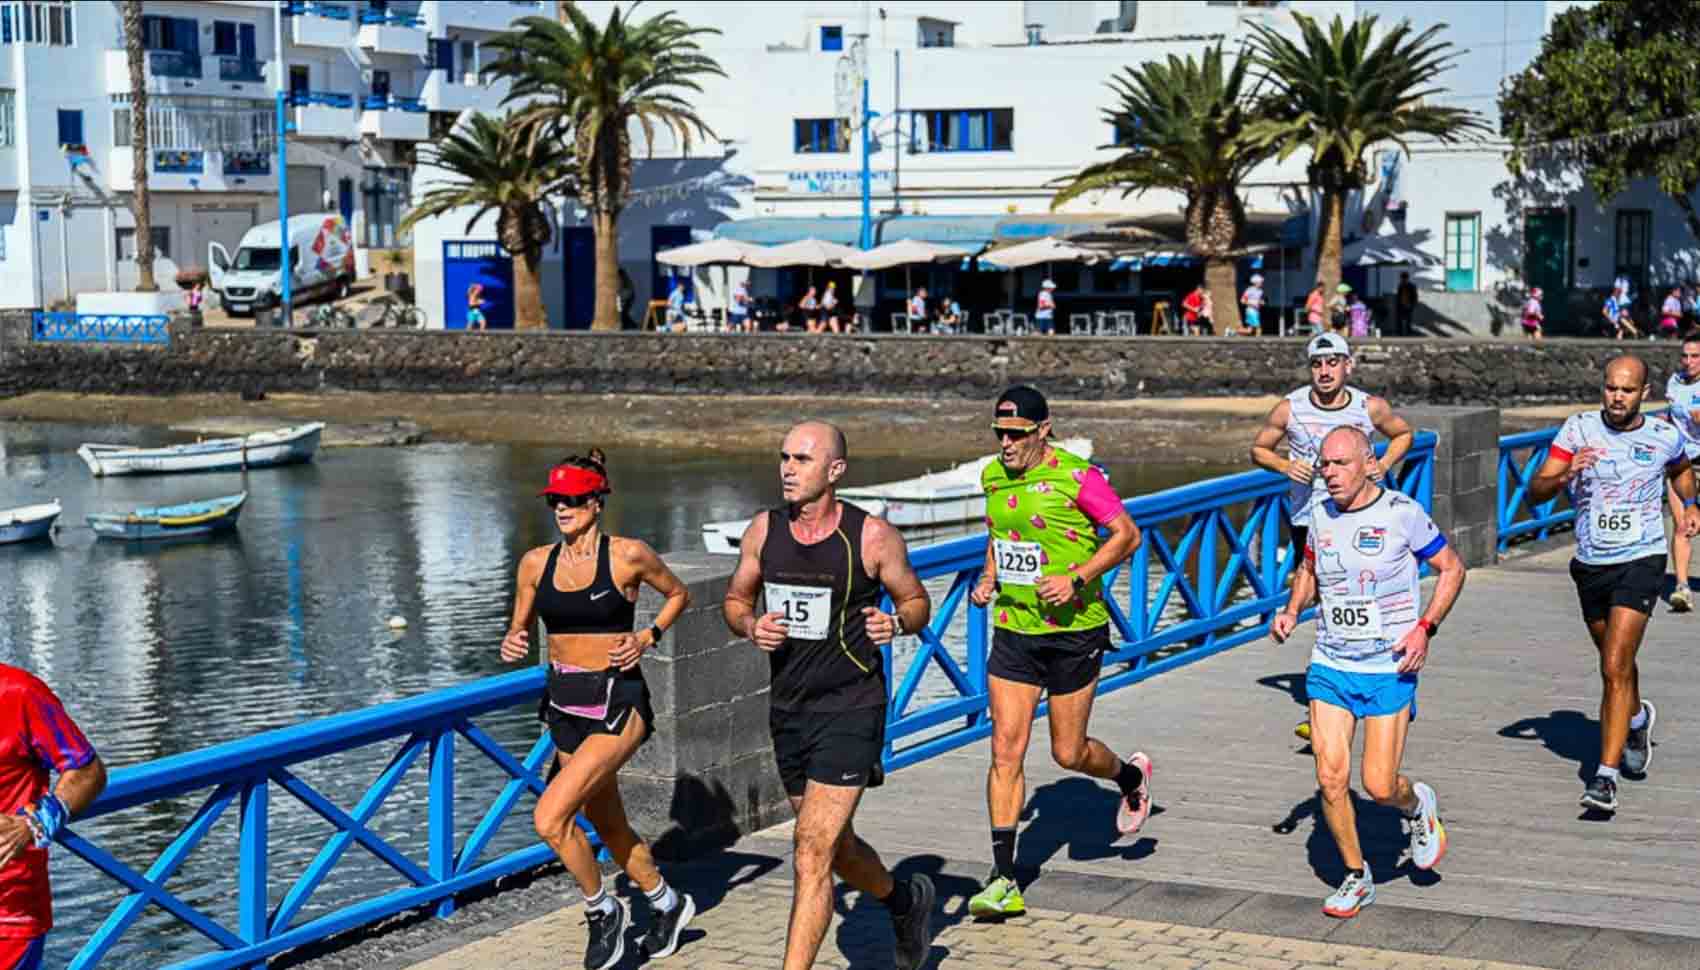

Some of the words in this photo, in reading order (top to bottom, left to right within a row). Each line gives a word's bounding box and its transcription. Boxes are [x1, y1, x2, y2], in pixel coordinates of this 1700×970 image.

[788, 171, 809, 181] BAR
[1598, 513, 1631, 531] 665
[998, 551, 1038, 573] 1229
[782, 599, 809, 623] 15
[1332, 606, 1369, 627] 805
